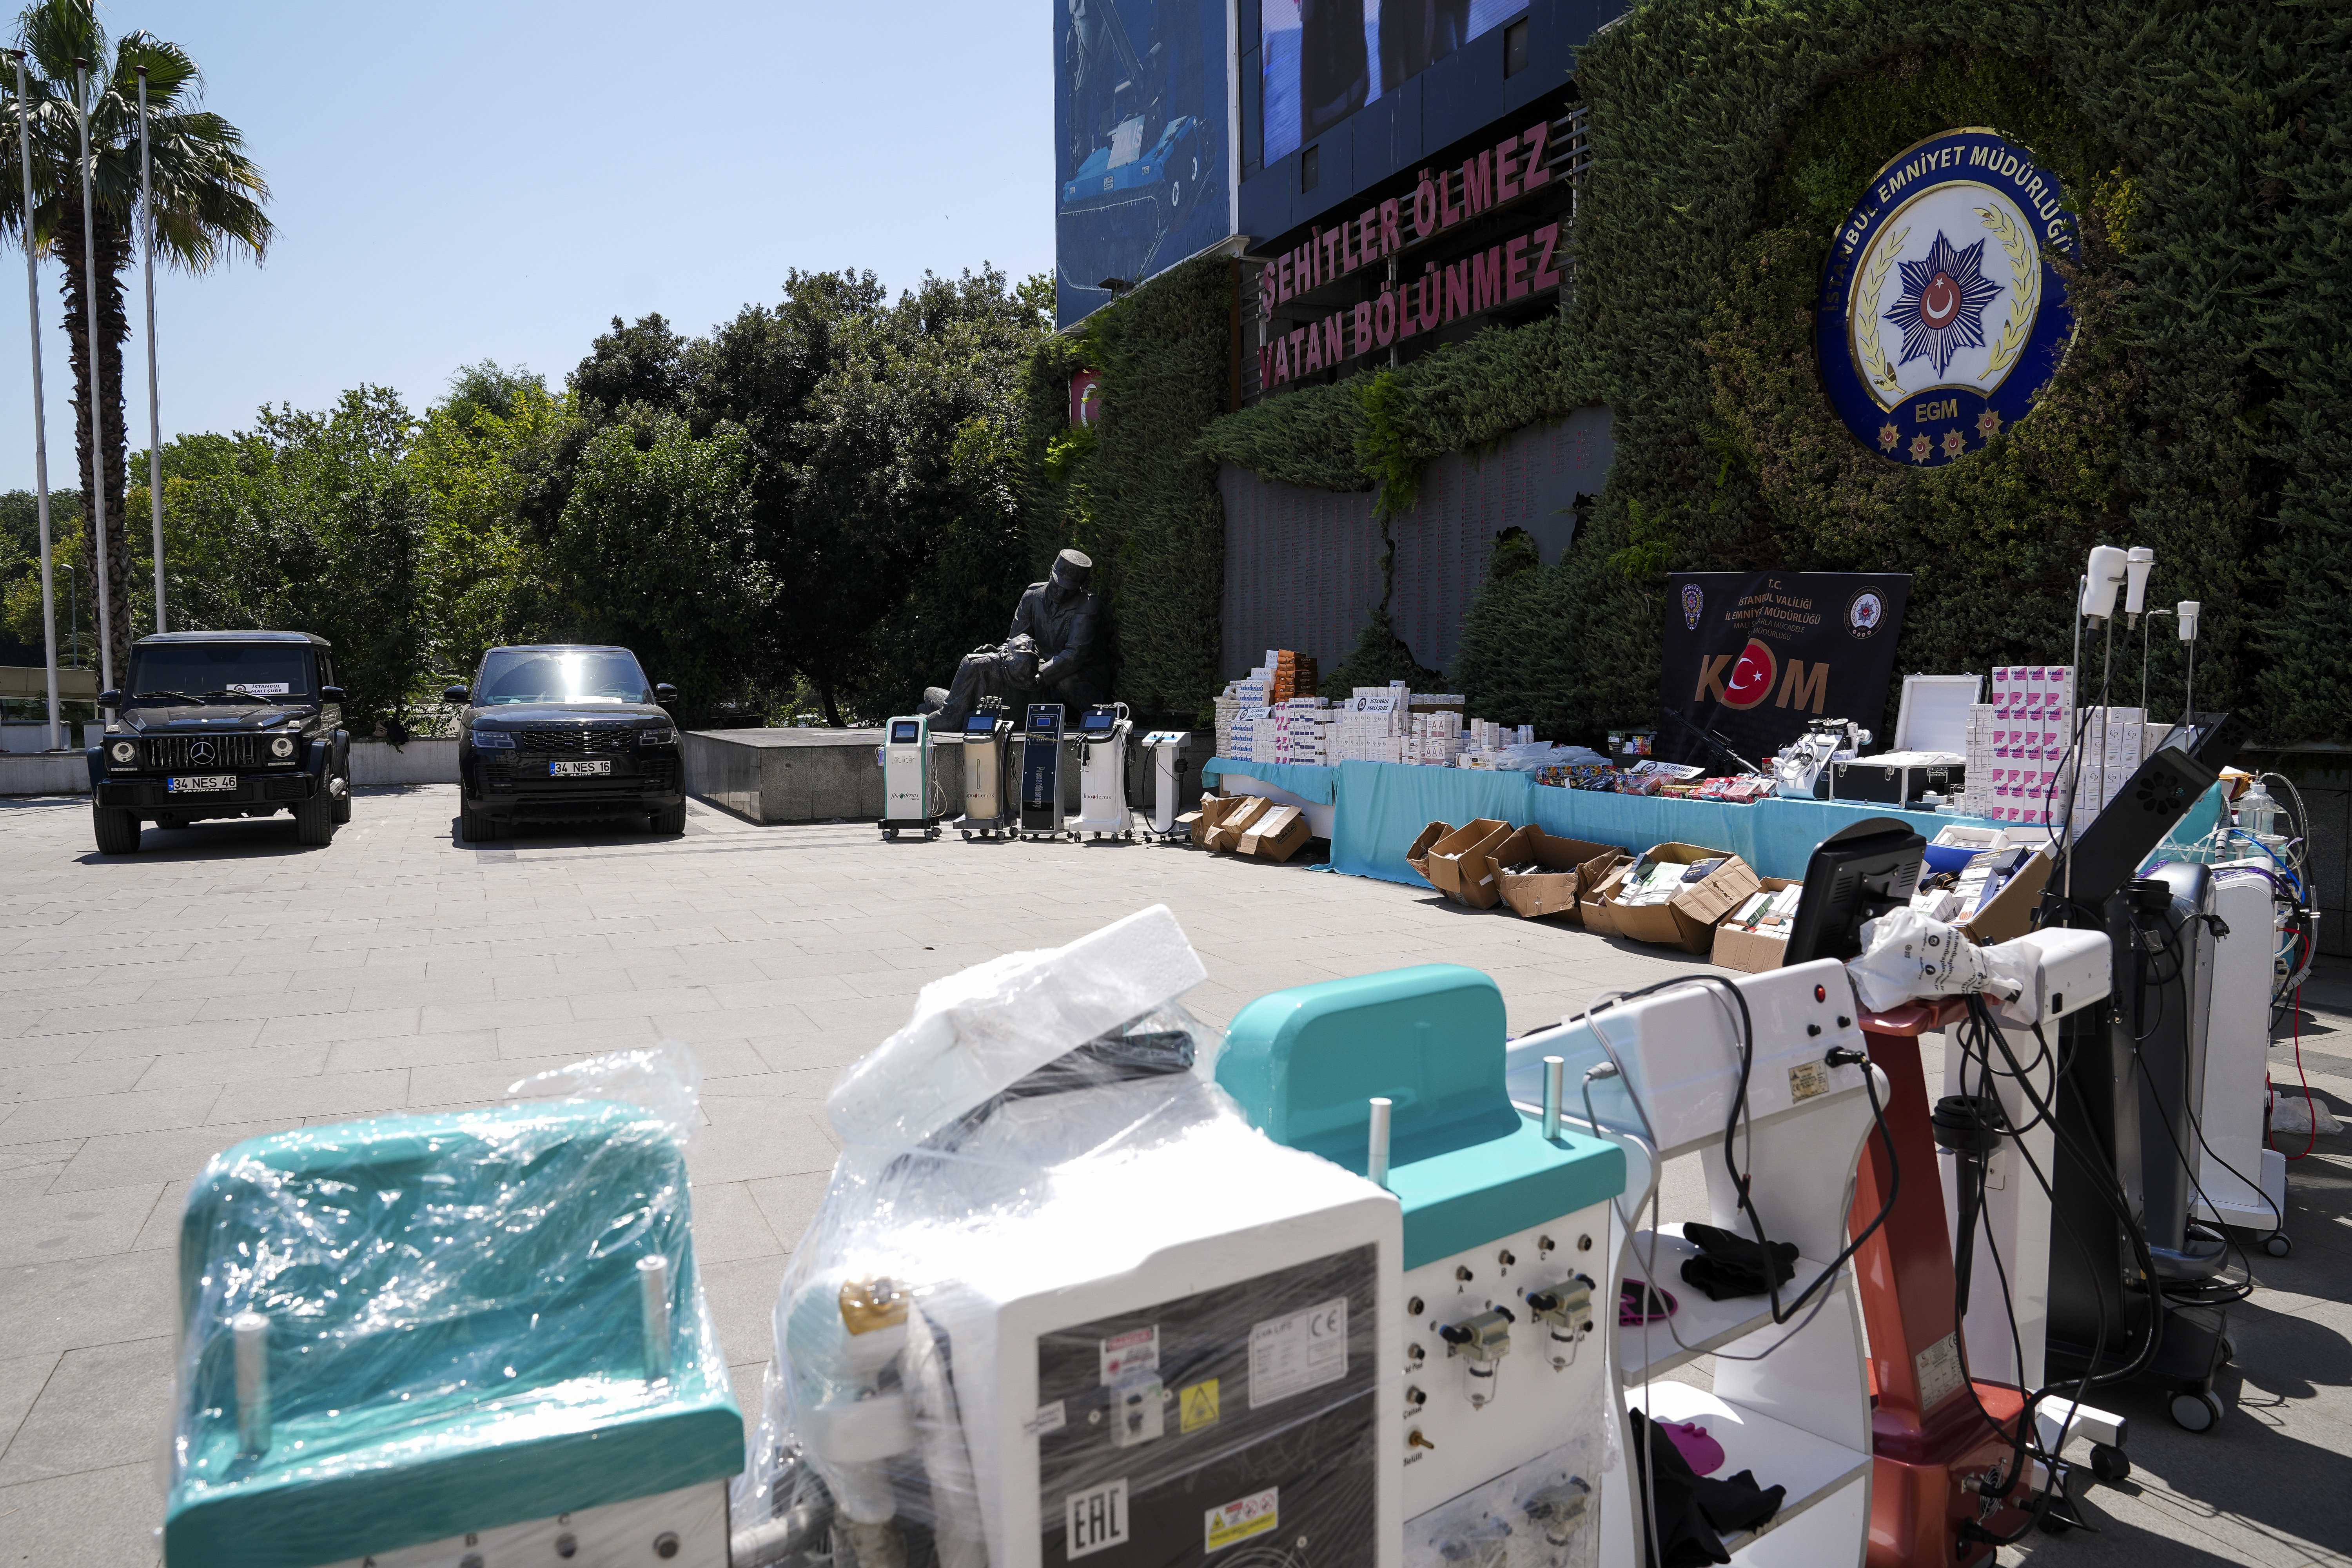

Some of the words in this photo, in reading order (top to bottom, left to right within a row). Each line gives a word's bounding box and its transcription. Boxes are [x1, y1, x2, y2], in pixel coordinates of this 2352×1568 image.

[1878, 146, 1965, 203] EMNİYET
[1262, 198, 1402, 322] ŞEHİTLER
[1414, 121, 1550, 237] ÖLMEZ
[1260, 311, 1342, 388] VATAN
[1355, 223, 1560, 355] BÖLÜNMEZ
[1915, 399, 1958, 422] EGM
[1769, 579, 1782, 590] T.C.
[1776, 595, 1813, 610] VALİLİĞİ
[1725, 611, 1732, 621] İL
[1764, 607, 1821, 624] MÜDÜRLÜĞÜ
[1753, 626, 1791, 641] MÜDÜRLÜĞÜ
[1773, 621, 1805, 633] MÜCADELE
[556, 763, 568, 773] 34
[573, 762, 595, 772] NES
[600, 762, 610, 771] 16
[1662, 764, 1694, 773] İSTANBUL
[174, 779, 188, 789] 34
[192, 777, 217, 788] NES
[222, 777, 235, 787] 46
[1033, 766, 1045, 808] Pressotherapy
[1457, 1285, 1464, 1294] A
[1311, 1309, 1337, 1337] CE
